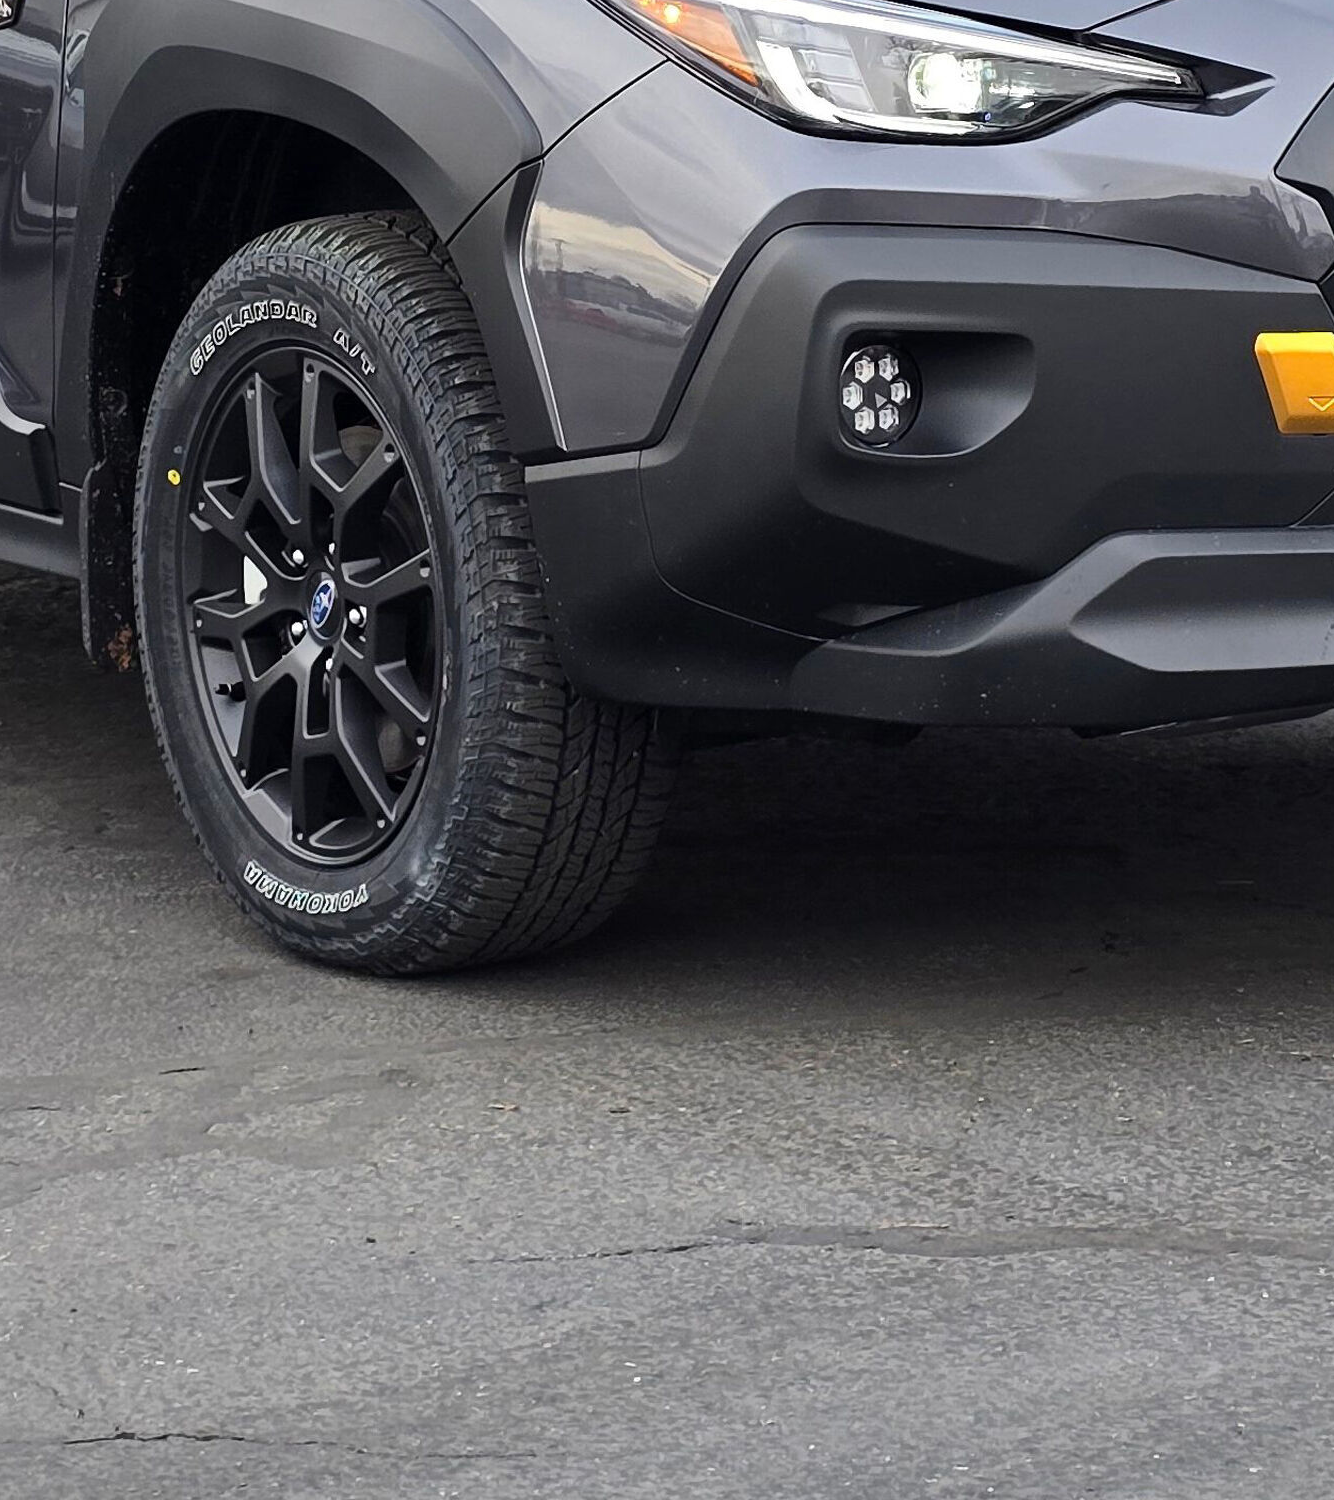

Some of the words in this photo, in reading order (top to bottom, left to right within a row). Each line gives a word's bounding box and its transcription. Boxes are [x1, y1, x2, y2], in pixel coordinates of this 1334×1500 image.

[189, 299, 318, 375] GEOLANDAR
[332, 327, 376, 376] A/T
[243, 860, 369, 914] YOKOHAMA
